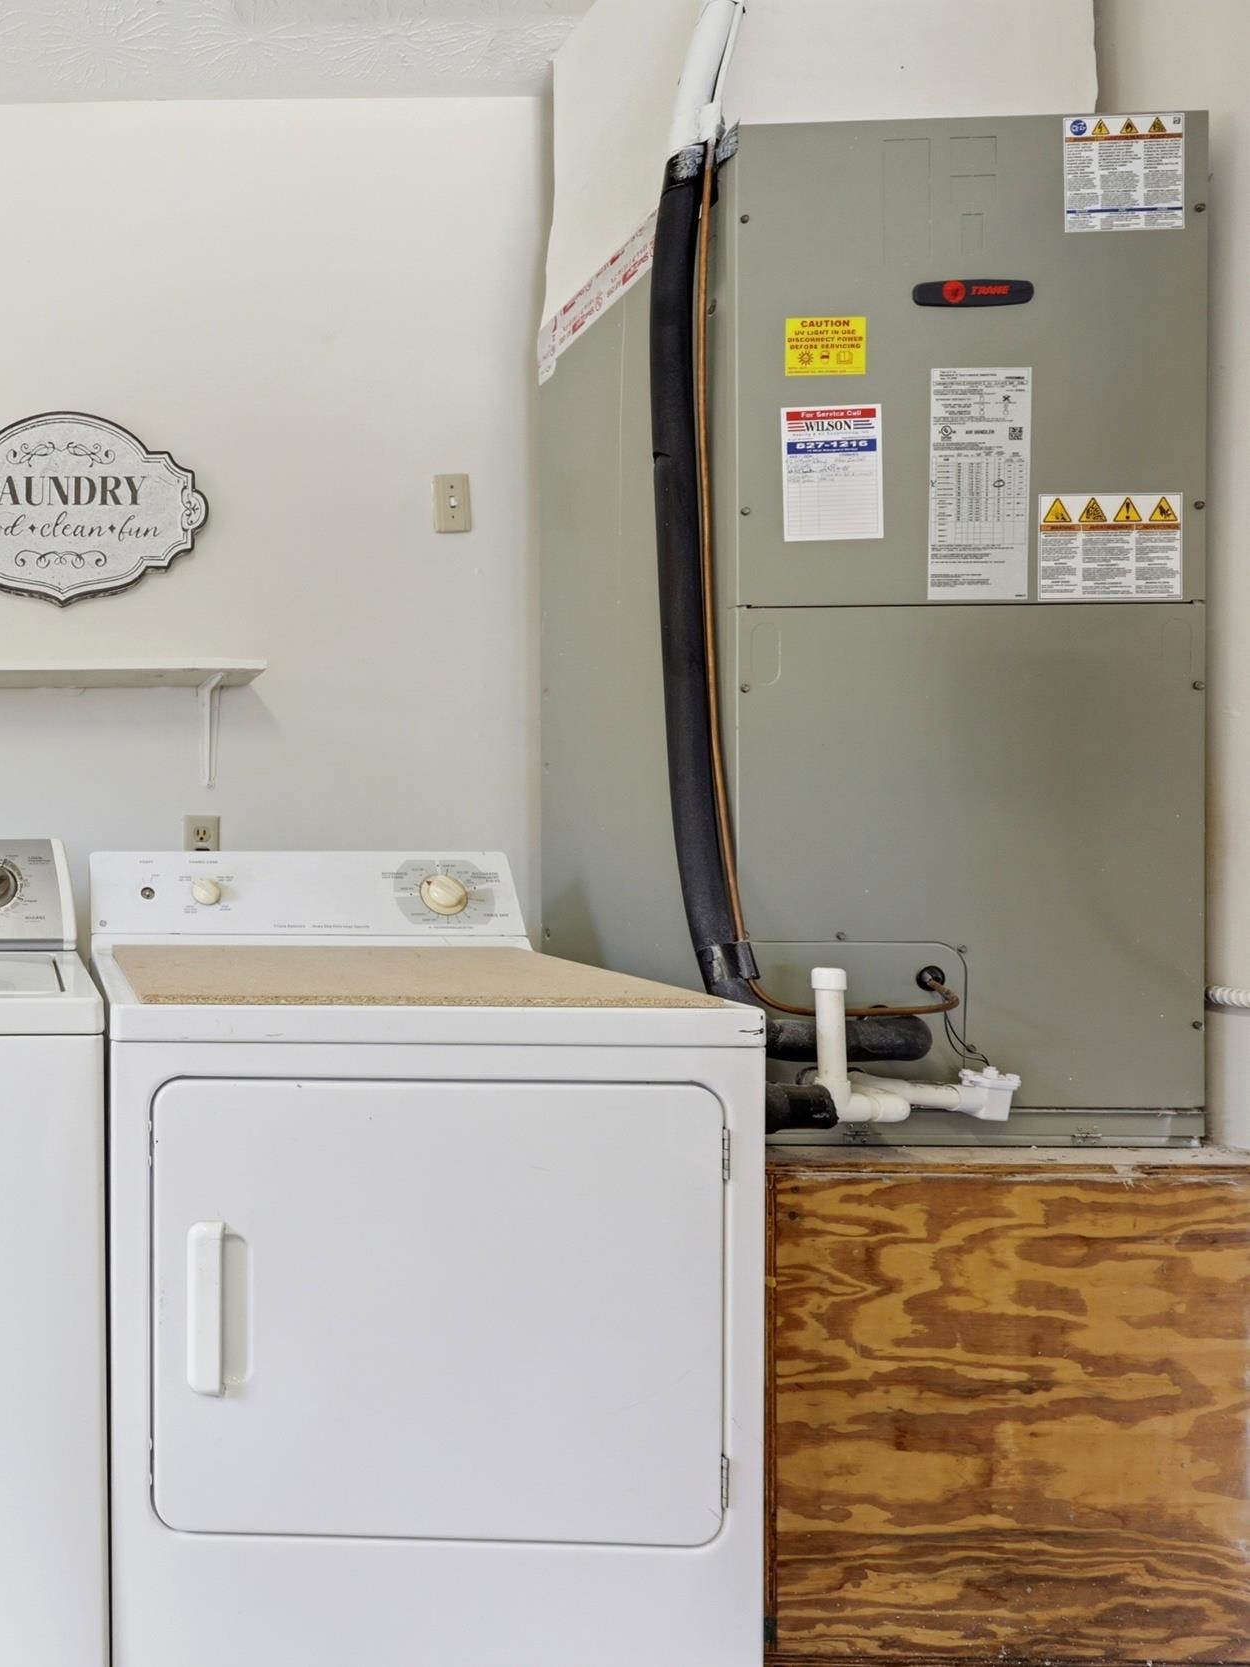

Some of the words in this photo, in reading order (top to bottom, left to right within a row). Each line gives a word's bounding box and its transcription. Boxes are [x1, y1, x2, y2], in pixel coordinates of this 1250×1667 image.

[971, 285, 1010, 296] TRANE
[800, 319, 850, 328] CAUTION
[805, 420, 852, 432] WILSON
[39, 511, 105, 538] clean
[118, 515, 160, 542] fun
